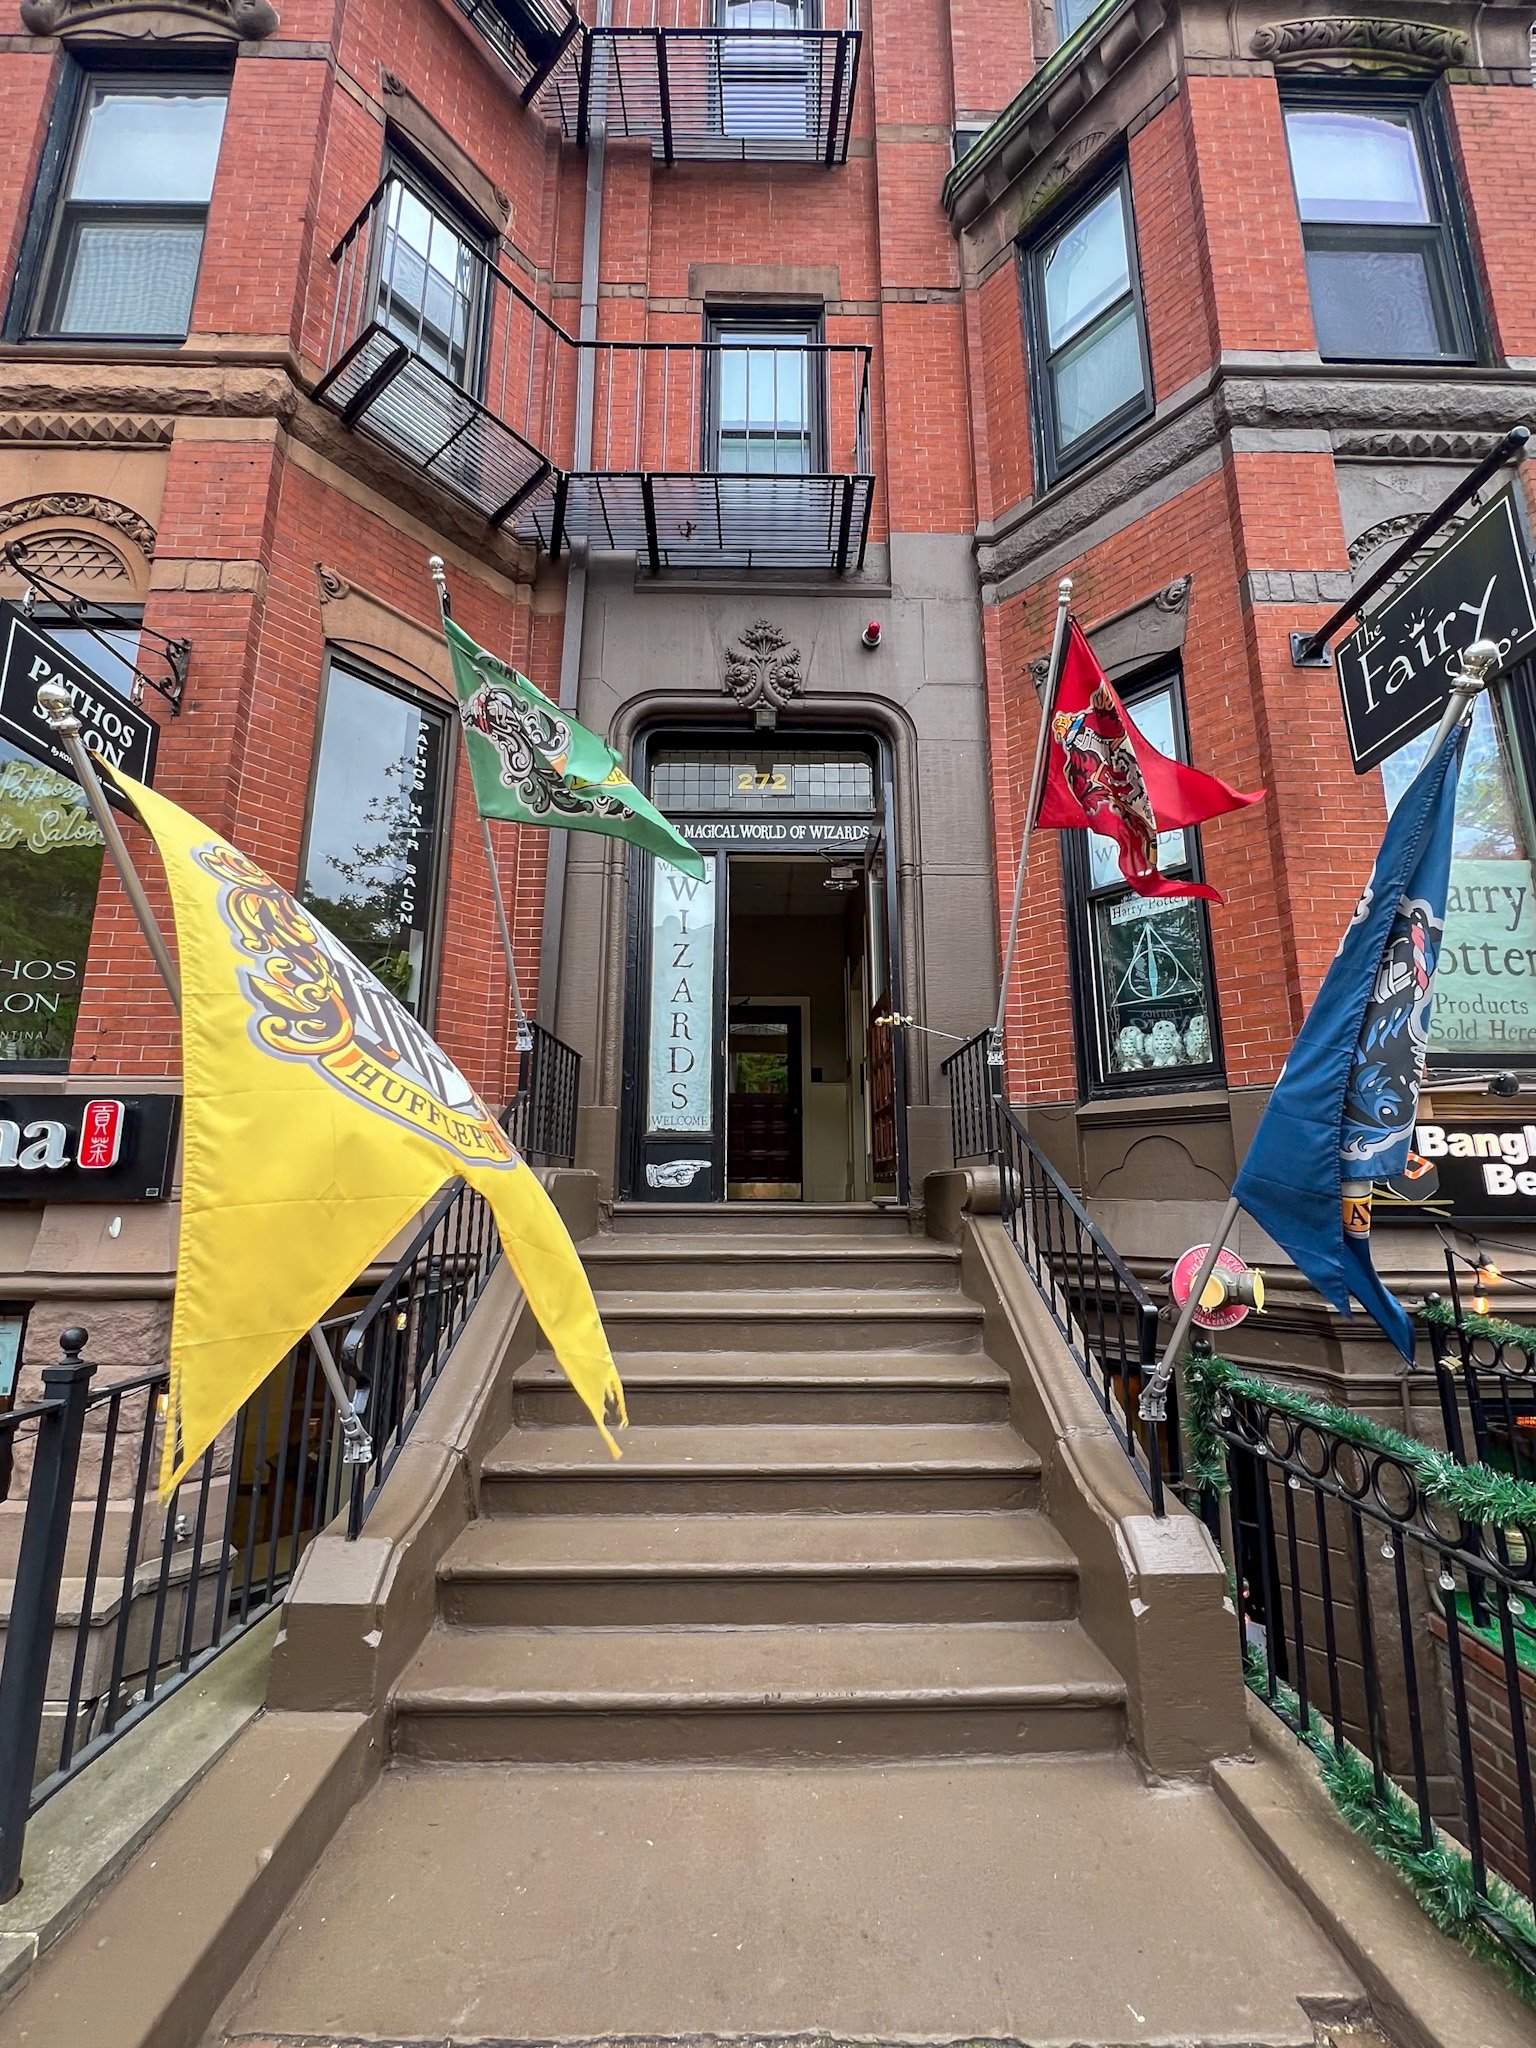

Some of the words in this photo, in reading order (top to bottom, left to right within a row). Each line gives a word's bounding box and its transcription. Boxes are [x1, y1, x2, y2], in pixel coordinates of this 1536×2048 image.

[1351, 623, 1382, 654] The
[1357, 573, 1498, 715] Fairy
[27, 654, 136, 748] PATHOS
[412, 721, 430, 792] PATHOS
[736, 773, 788, 791] 272
[32, 809, 106, 848] Salon
[407, 803, 423, 851] HAIR
[684, 824, 739, 839] MAGICAL
[740, 824, 787, 841] WORLD
[789, 825, 807, 839] OF
[809, 824, 870, 841] WIZARDS
[399, 863, 418, 926] SALON
[1111, 901, 1145, 920] Harry
[667, 875, 700, 1110] WIZARDS
[1434, 992, 1529, 1015] Products
[1430, 1019, 1478, 1041] Sold
[1488, 1019, 1536, 1041] Here
[651, 1115, 709, 1127] WELCOME
